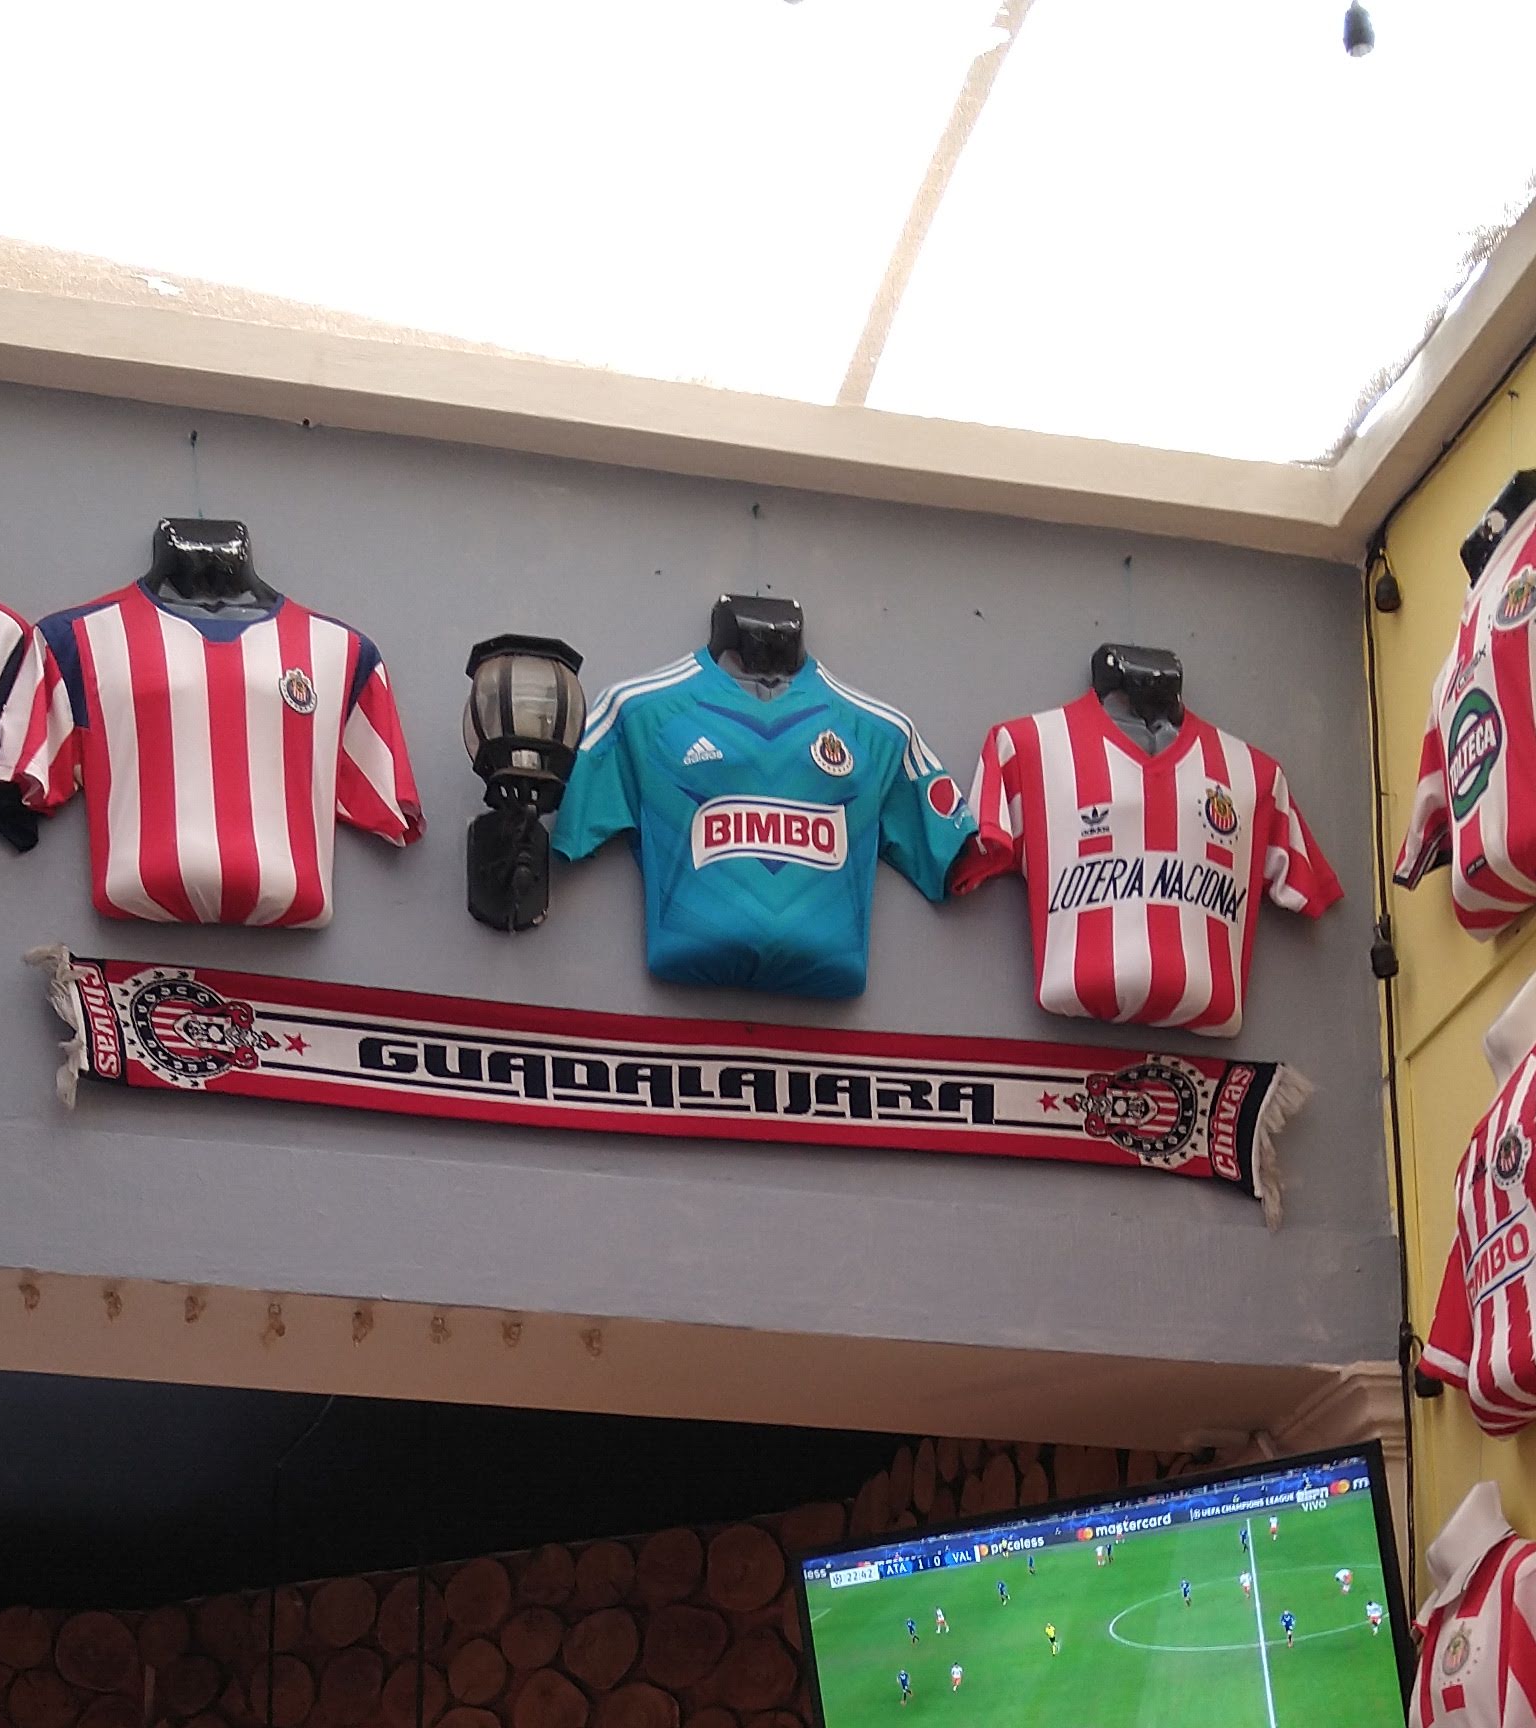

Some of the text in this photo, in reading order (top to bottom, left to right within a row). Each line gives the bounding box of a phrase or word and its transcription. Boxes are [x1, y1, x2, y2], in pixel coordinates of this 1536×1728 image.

[1450, 717, 1497, 797] TOLTECA
[704, 812, 835, 853] BIMBO
[1049, 856, 1145, 914] LOTERIA
[360, 1036, 998, 1125] GUADALAJARA
[1214, 1067, 1254, 1178] Chivas
[1201, 1507, 1221, 1517] UEFA
[1301, 1499, 1327, 1512] VIVO
[886, 1563, 908, 1575] ATA
[918, 1559, 924, 1570] 1
[933, 1556, 941, 1567] 0
[951, 1550, 973, 1563] VAL
